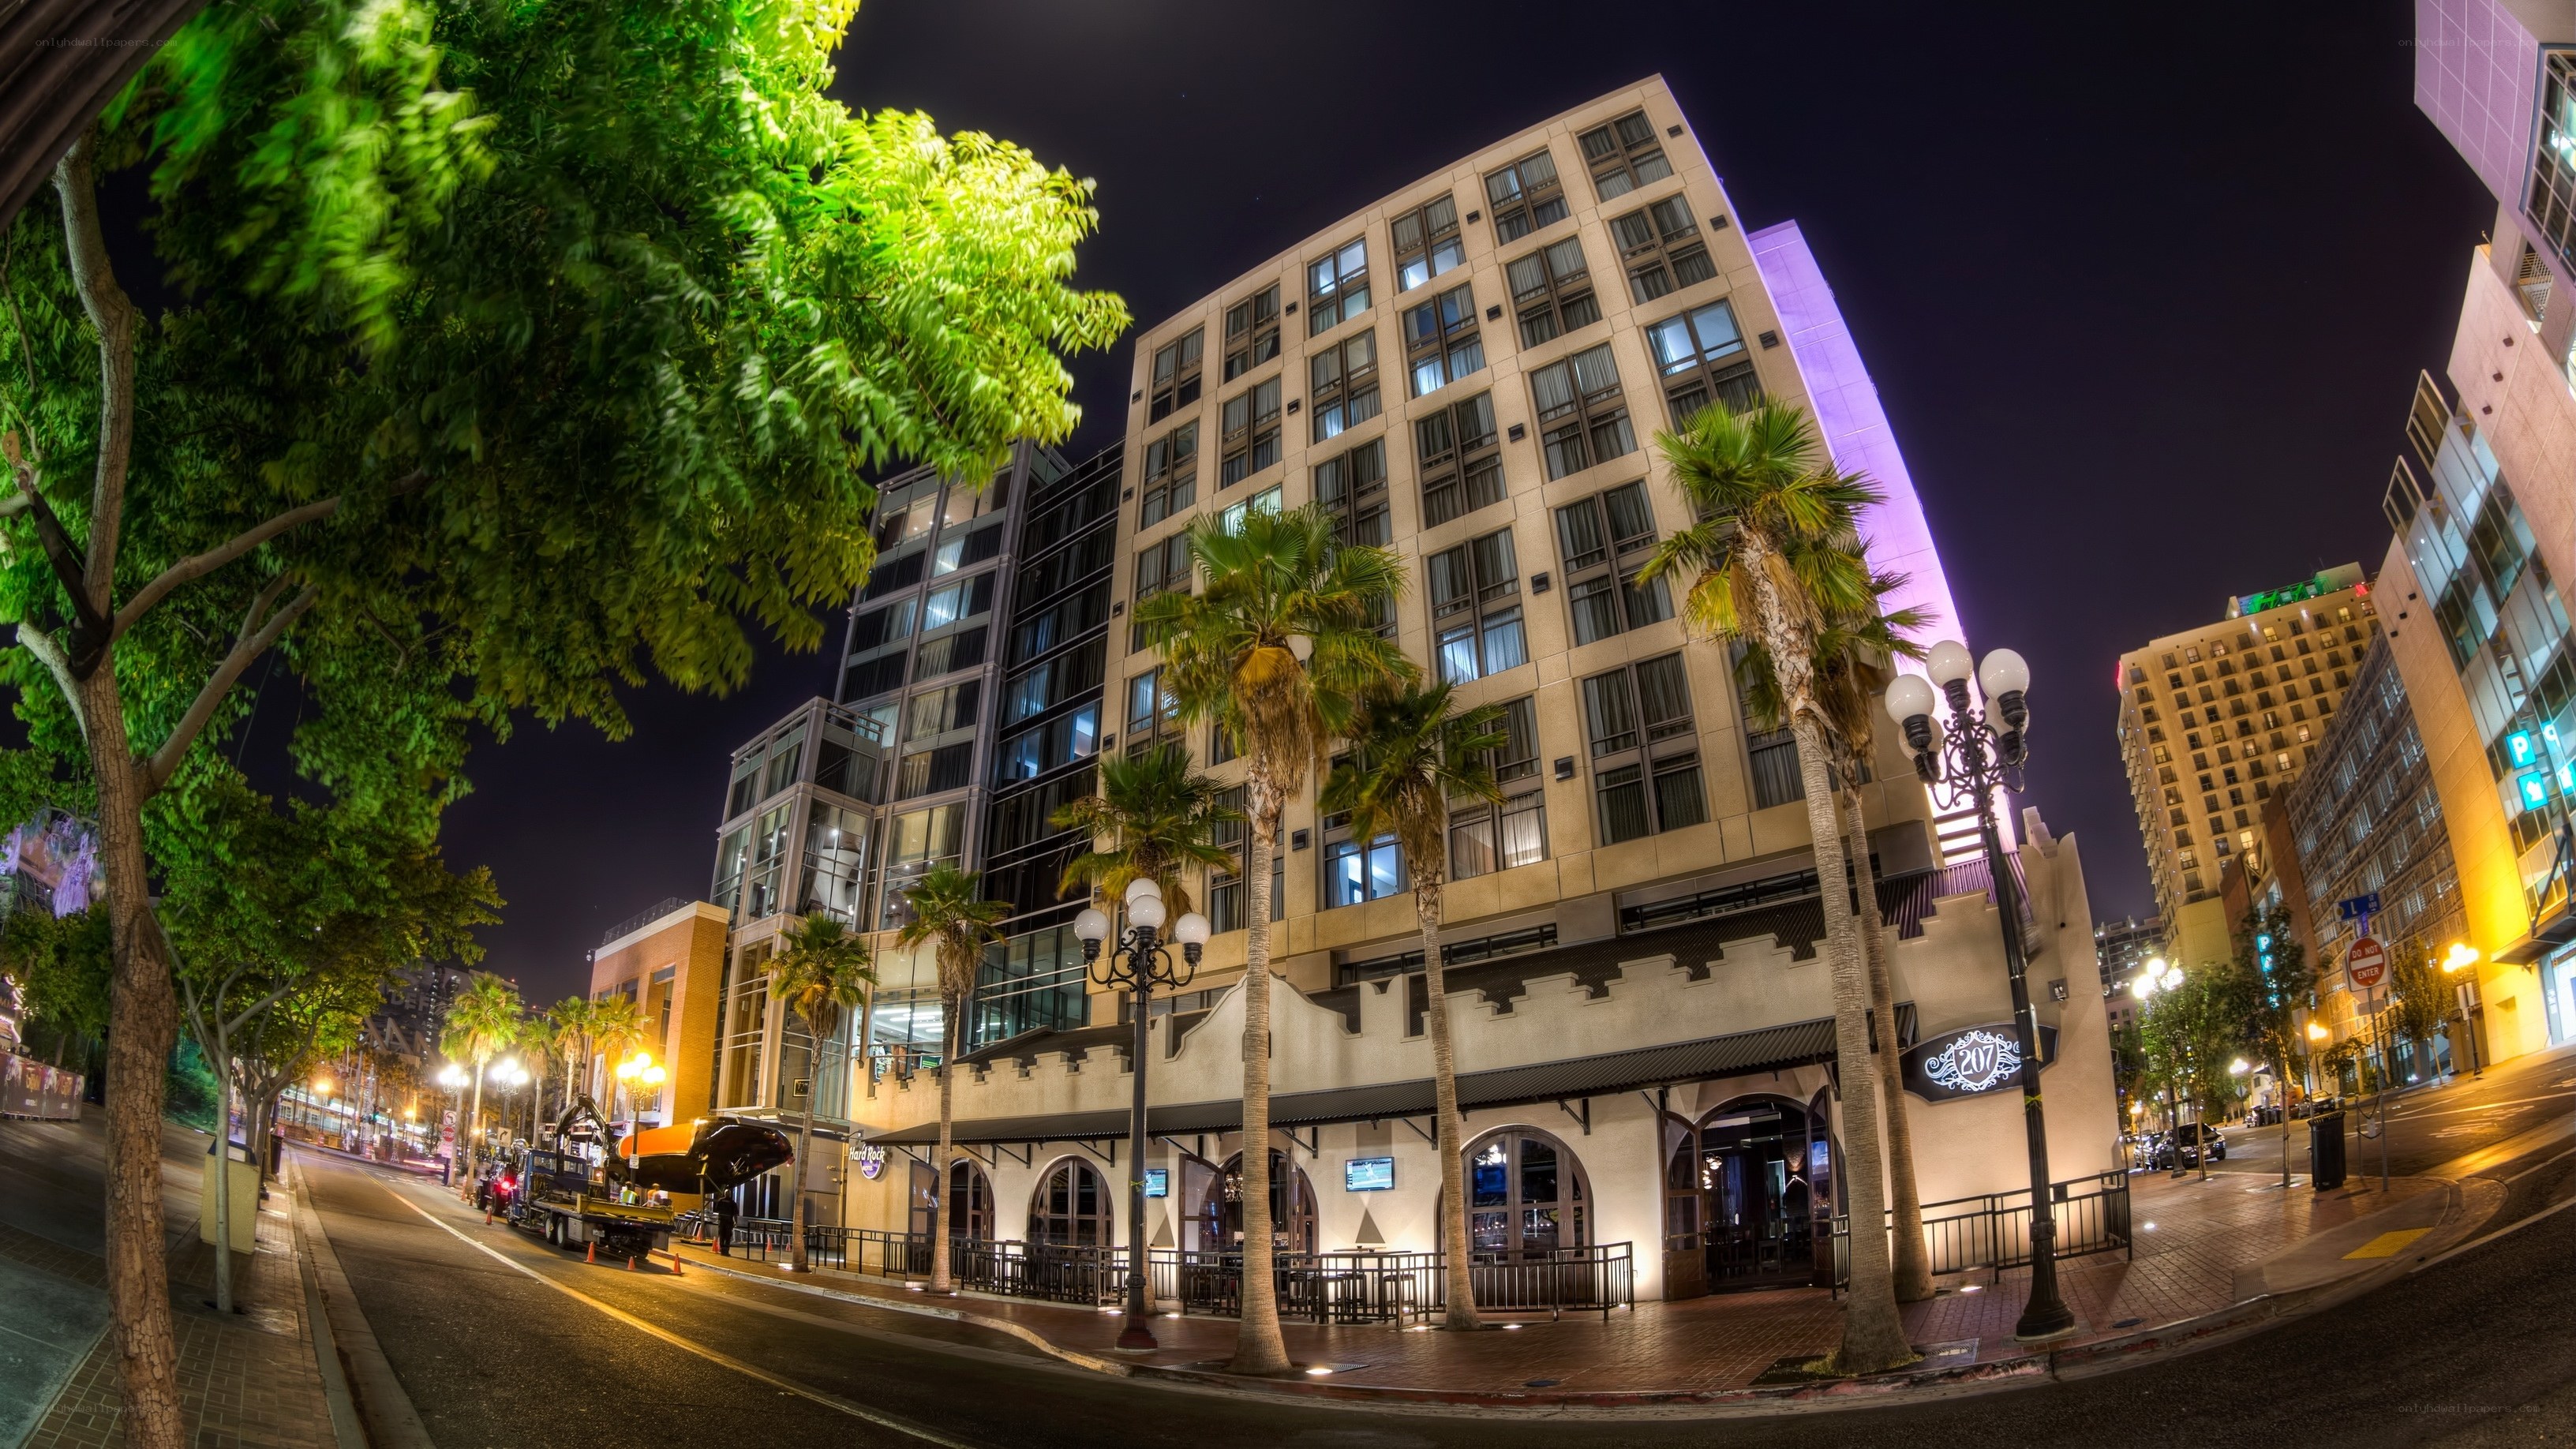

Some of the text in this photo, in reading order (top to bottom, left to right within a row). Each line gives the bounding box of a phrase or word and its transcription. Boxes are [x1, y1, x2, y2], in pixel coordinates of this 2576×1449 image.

[2511, 736, 2529, 762] P
[2350, 901, 2358, 915] L
[2352, 945, 2379, 959] DO NOT
[2357, 968, 2380, 979] ENTER
[1959, 1044, 1994, 1076] 207
[849, 1144, 886, 1164] Hard Rock
